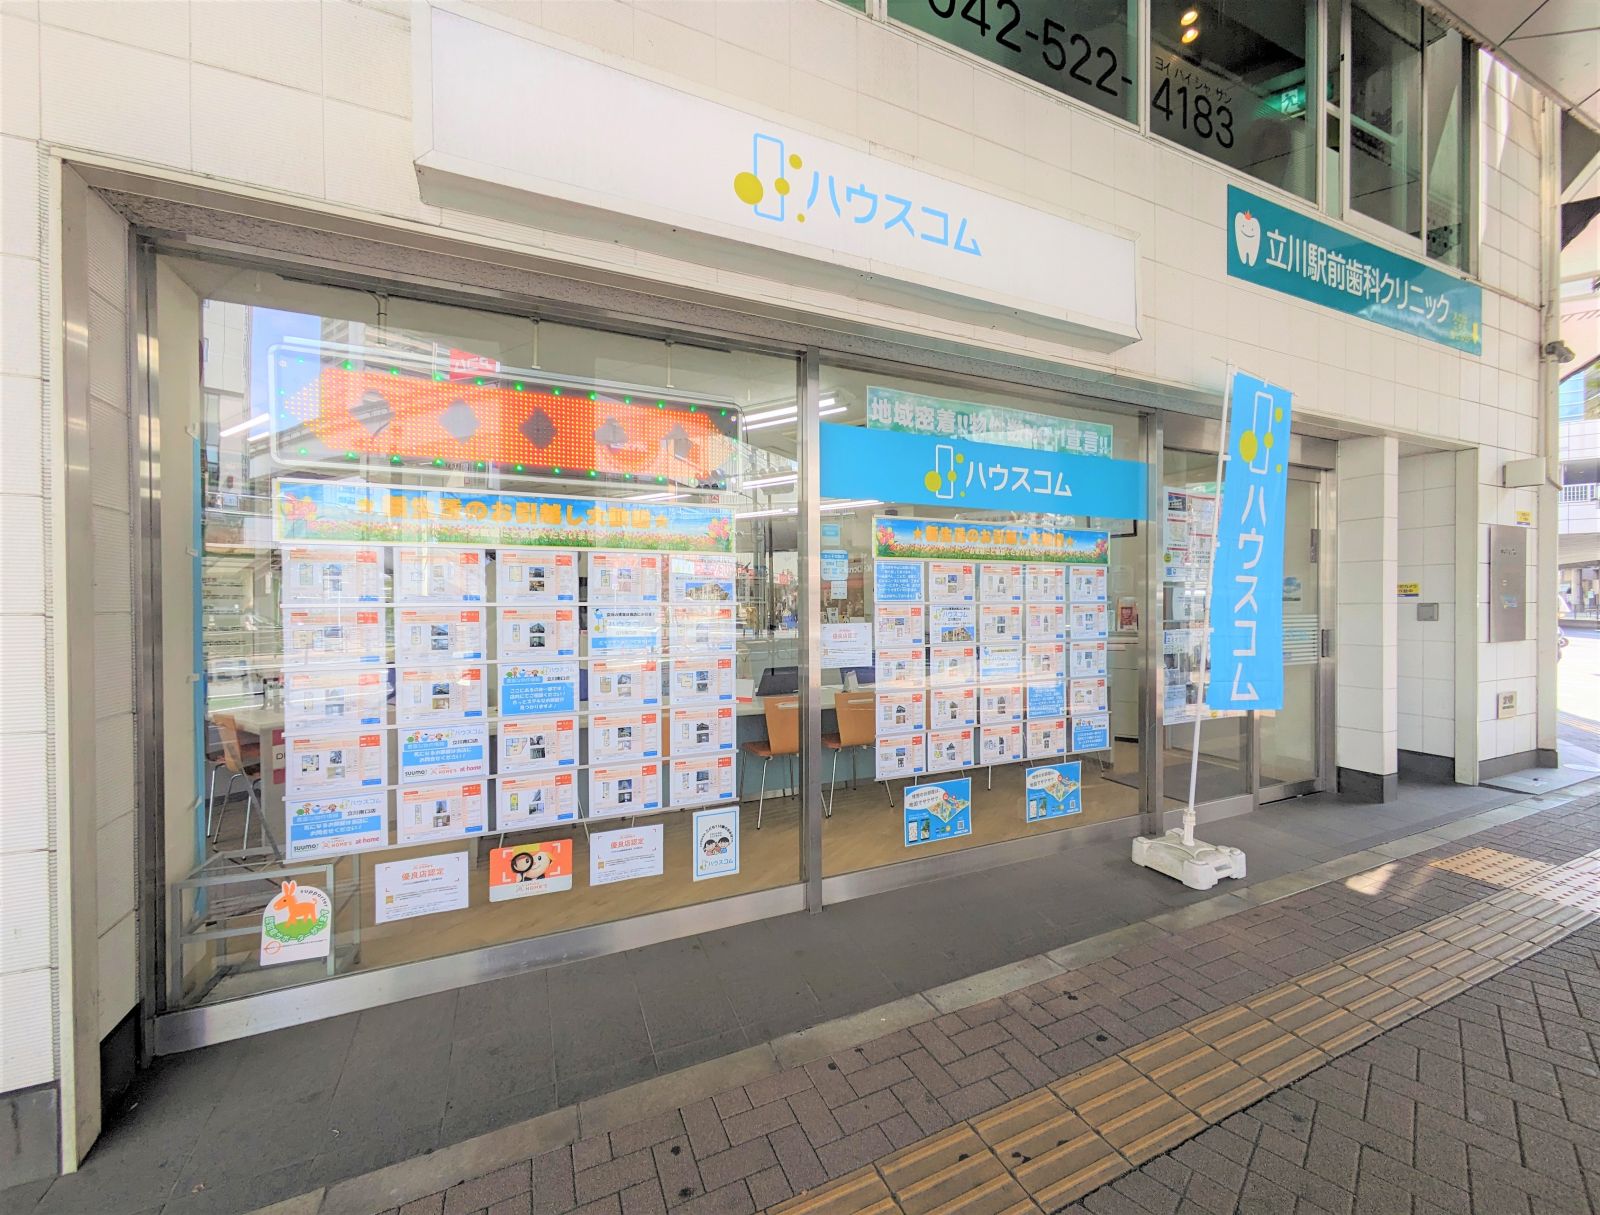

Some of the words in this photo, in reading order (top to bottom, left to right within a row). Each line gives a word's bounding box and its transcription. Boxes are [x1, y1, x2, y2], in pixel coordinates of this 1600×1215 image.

[1152, 77, 1234, 148] 4183
[807, 171, 982, 256] ハウスコム
[1266, 229, 1449, 323] 立川駅前歯科クリニック
[966, 461, 1072, 497] ハウスコム
[1230, 484, 1266, 702] ハウスコム
[300, 889, 329, 908] supporter
[401, 867, 445, 881] 優良店認定
